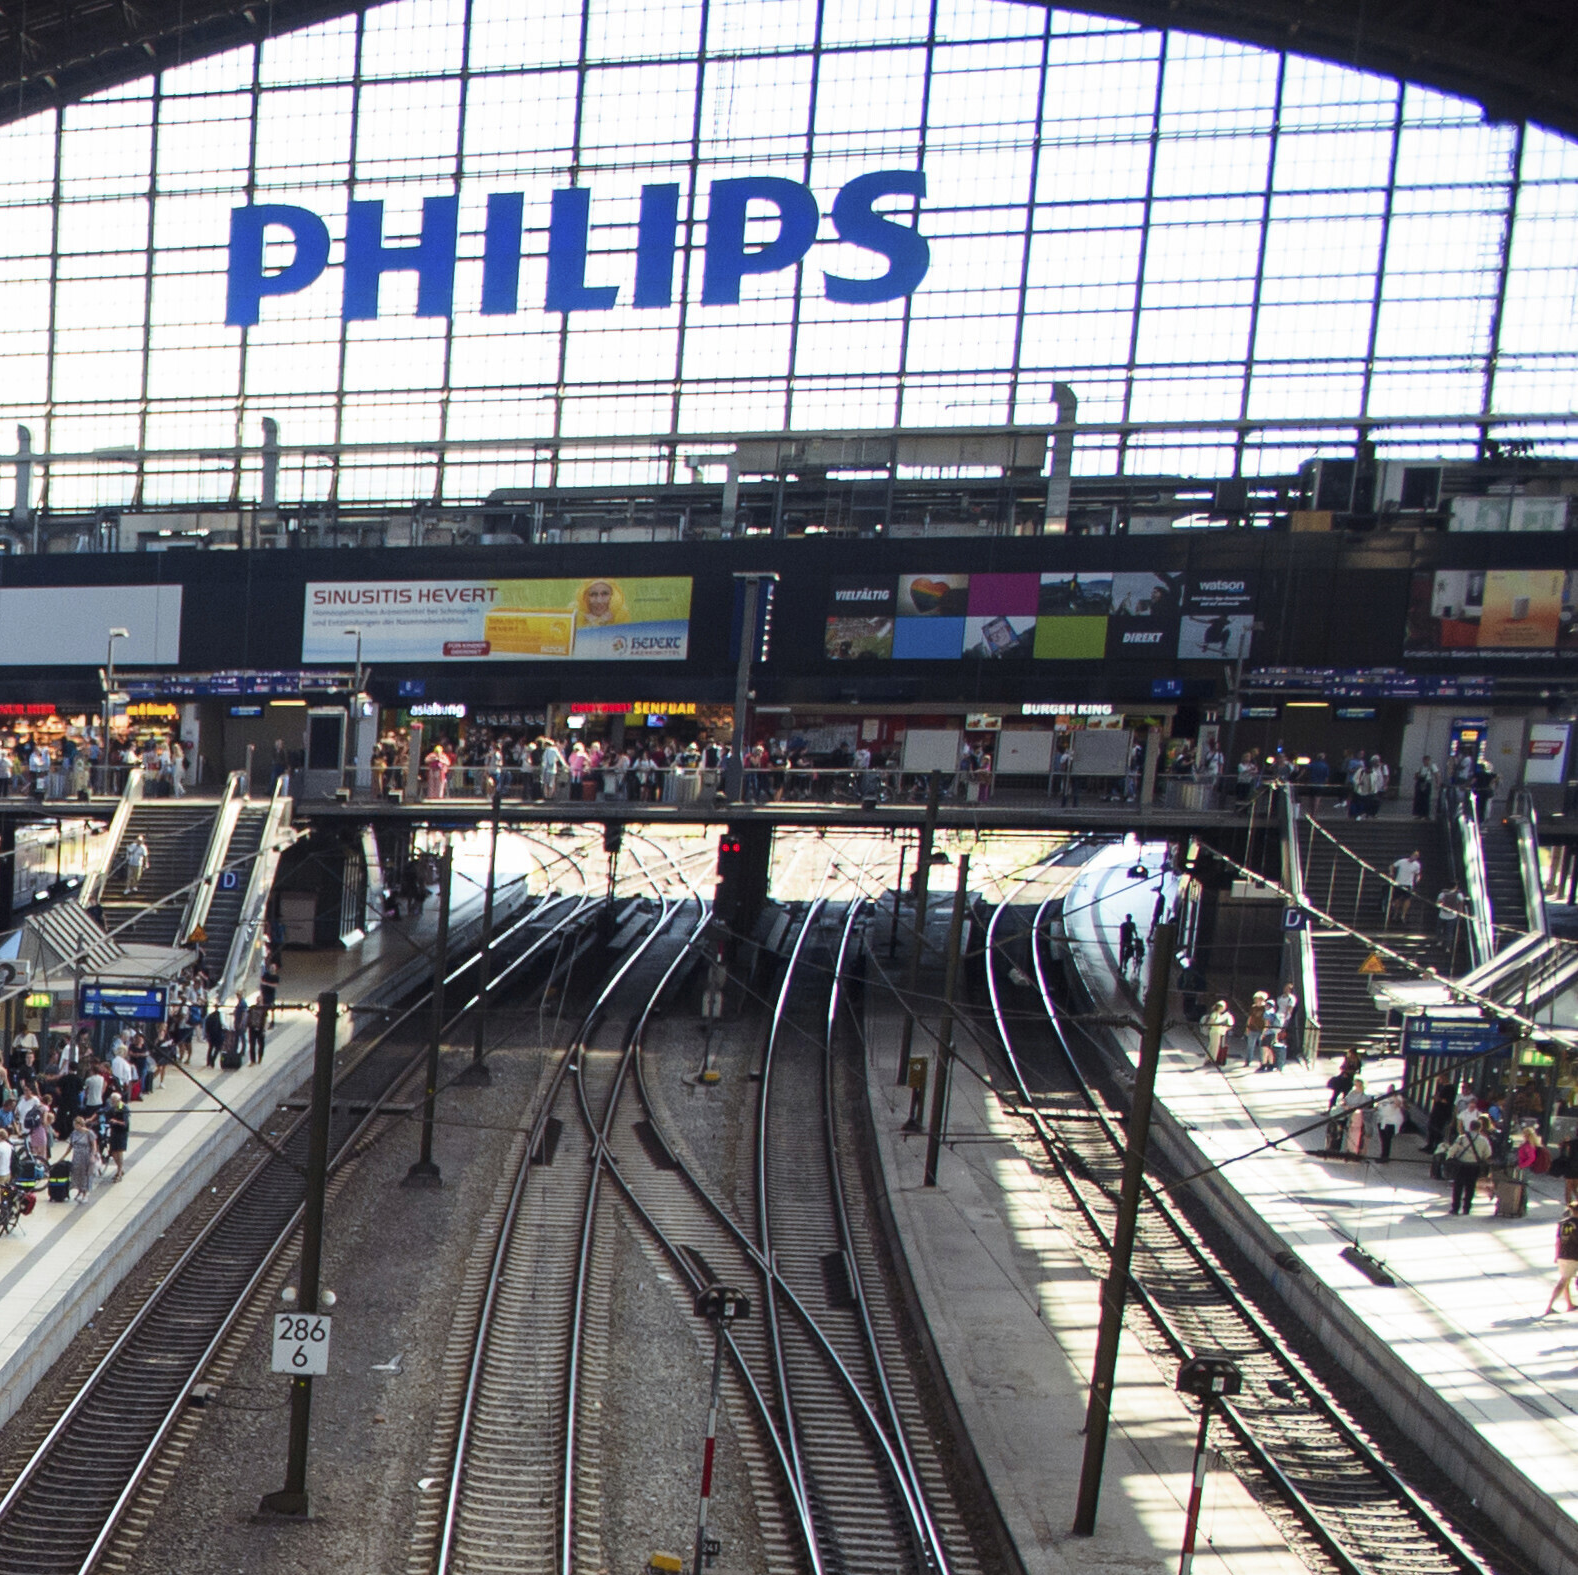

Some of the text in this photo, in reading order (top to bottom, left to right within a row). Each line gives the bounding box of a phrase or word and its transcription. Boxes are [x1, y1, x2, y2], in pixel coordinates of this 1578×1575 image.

[223, 168, 931, 329] PHILIPS
[835, 587, 890, 601] VIELFÄLTIG
[1199, 580, 1245, 591] watson
[313, 587, 499, 605] SINUSITIS HEVERT
[1122, 632, 1163, 643] DIREKT
[1022, 703, 1113, 715] BURGER KING
[224, 872, 236, 888] D
[1284, 909, 1301, 928] D
[279, 1317, 325, 1342] 286
[292, 1345, 308, 1368] 6
